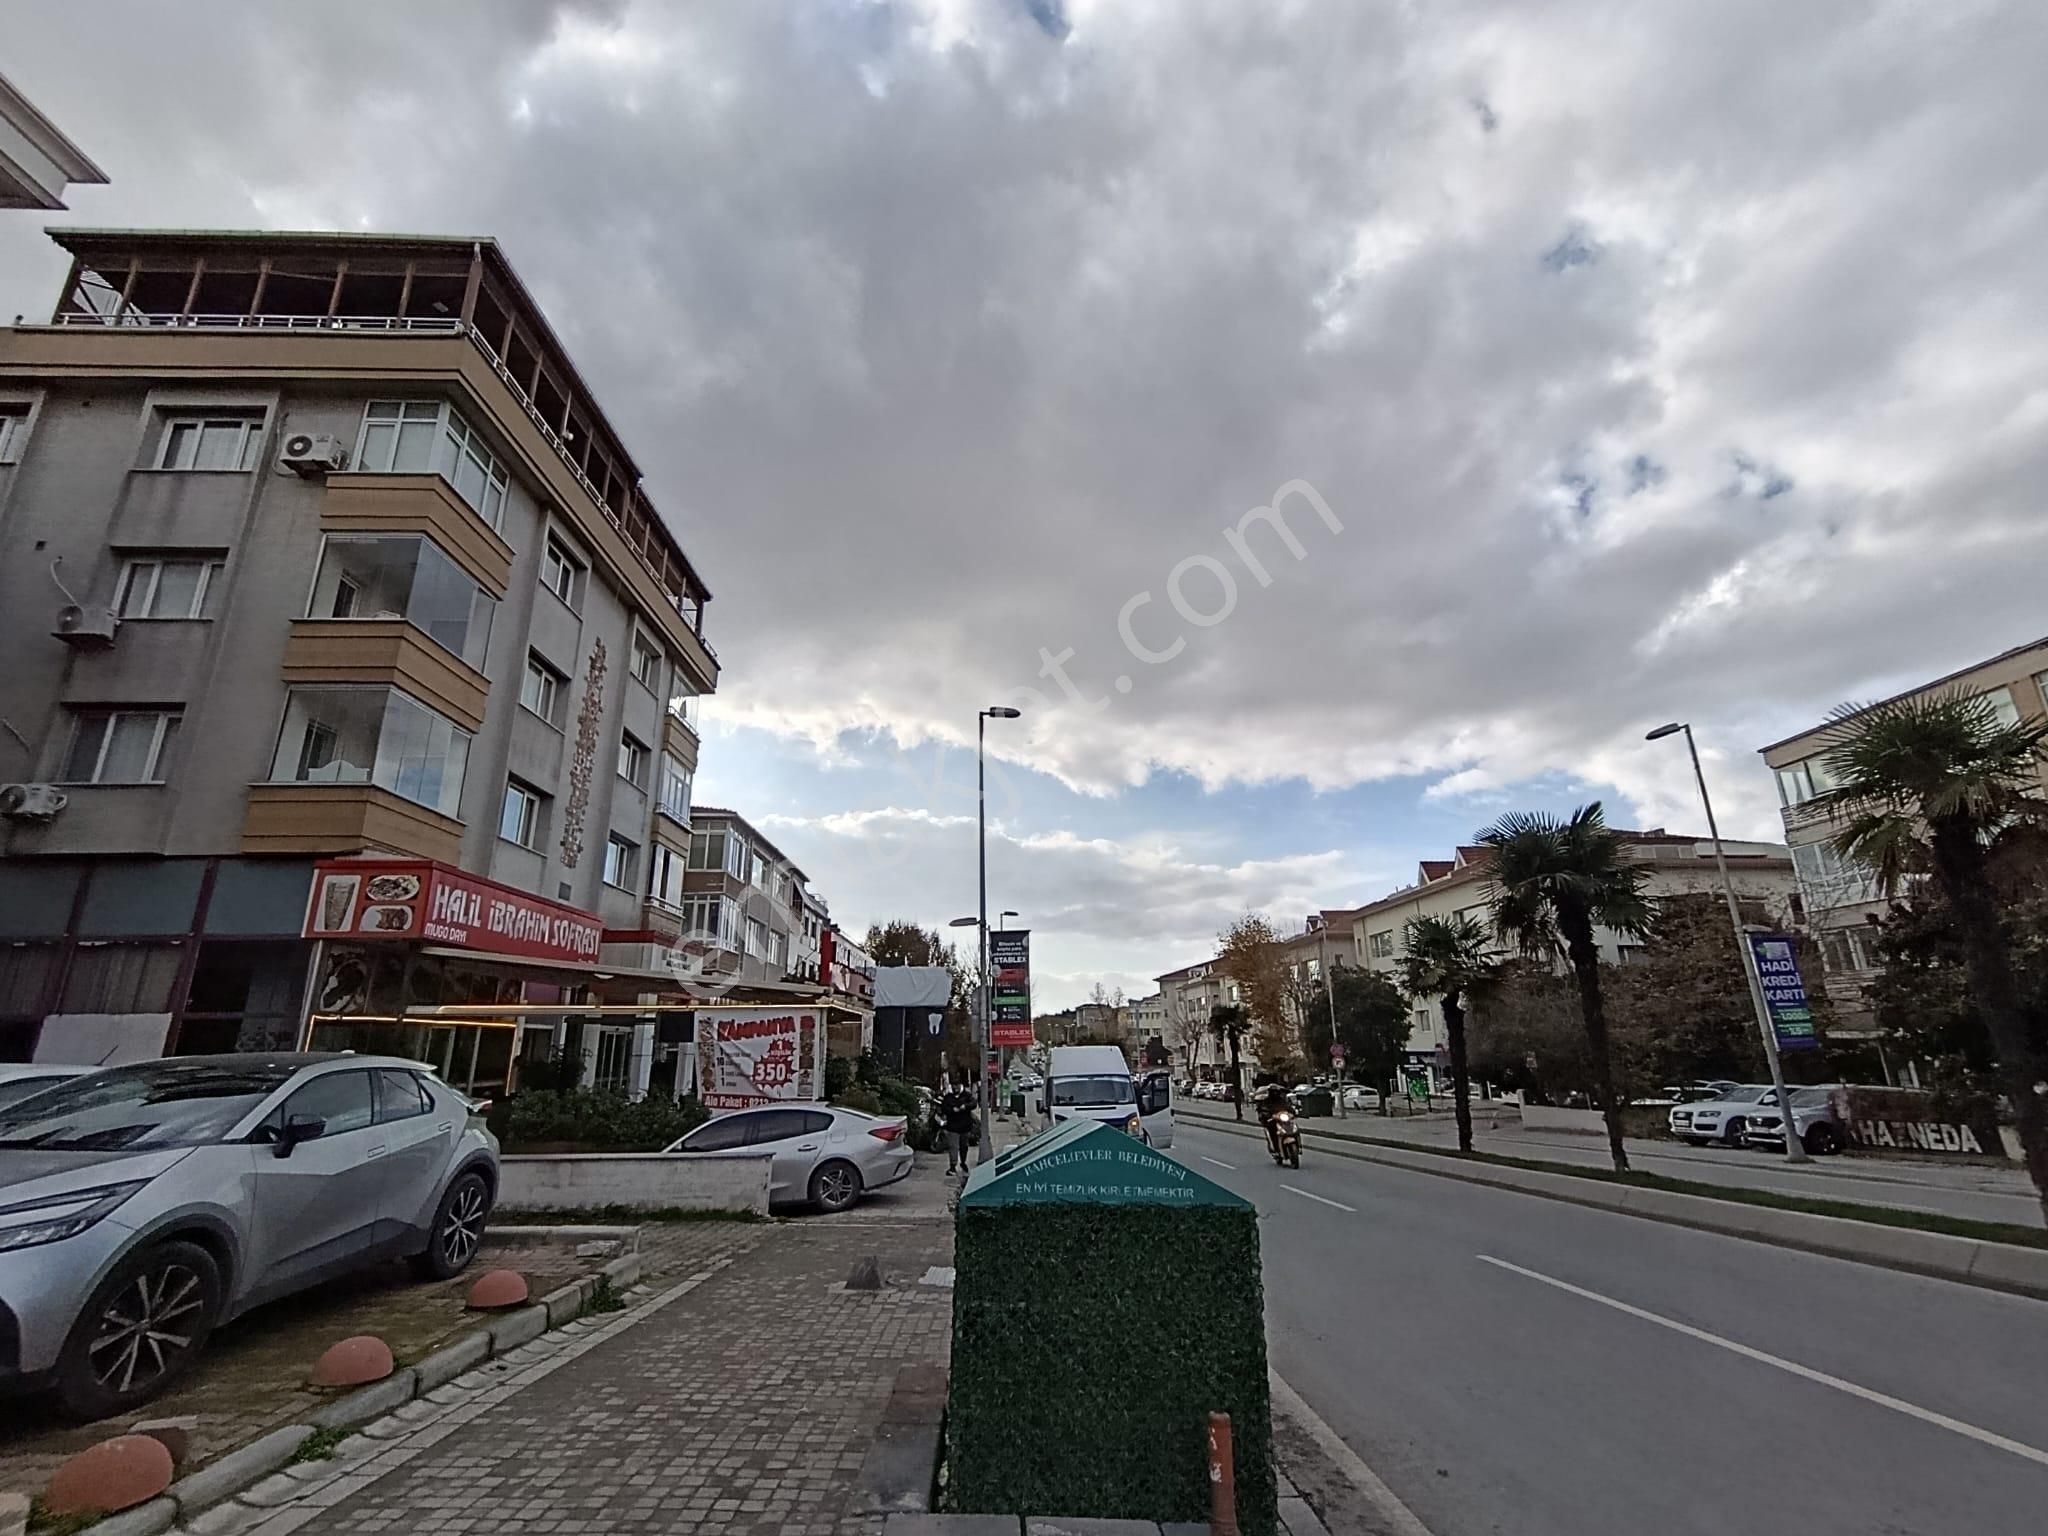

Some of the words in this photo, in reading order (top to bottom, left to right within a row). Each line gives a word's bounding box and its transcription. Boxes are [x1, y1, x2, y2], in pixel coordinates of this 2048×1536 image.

[551, 919, 600, 956] SOFRASI
[1761, 958, 1795, 972] HADİ
[1761, 972, 1802, 987] KREDİ
[1765, 989, 1805, 1001] KARTI
[994, 1029, 1031, 1037] STABLEX
[755, 1063, 786, 1081] 350
[704, 1095, 718, 1106] Alo
[719, 1096, 743, 1108] Paket
[1016, 1183, 1031, 1194] EN
